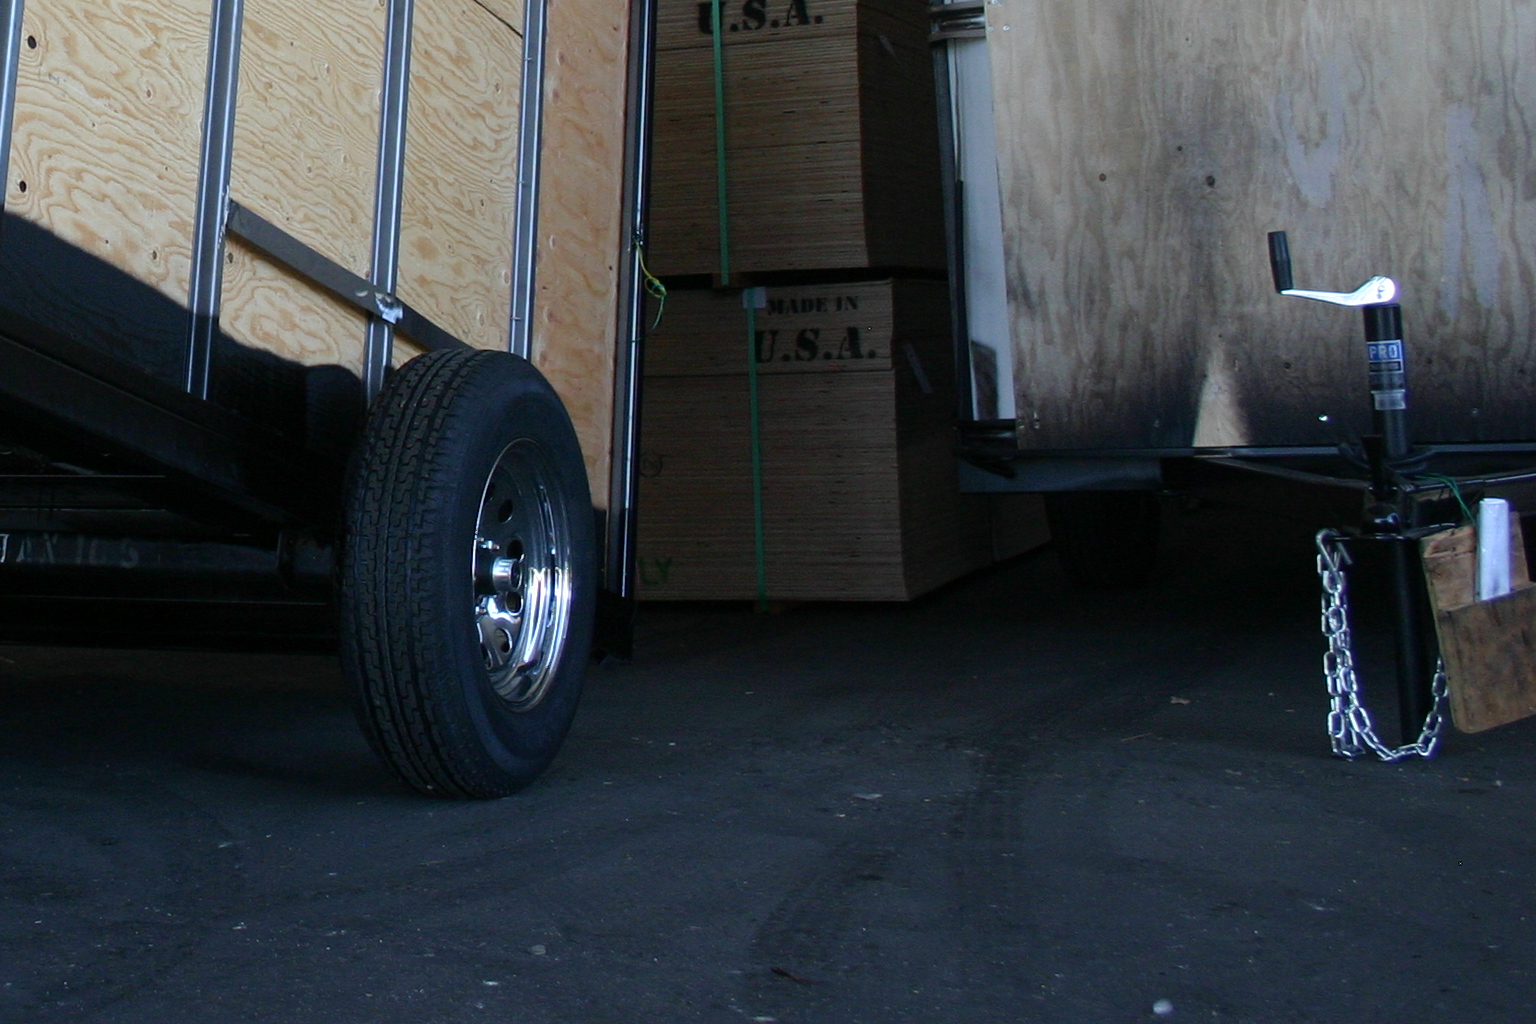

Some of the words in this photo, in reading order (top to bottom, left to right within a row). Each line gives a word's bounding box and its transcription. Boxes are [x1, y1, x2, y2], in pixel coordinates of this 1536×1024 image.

[767, 298, 827, 316] MADE
[835, 295, 858, 311] IN
[754, 326, 876, 364] U.S.A.
[1368, 344, 1398, 360] PRO
